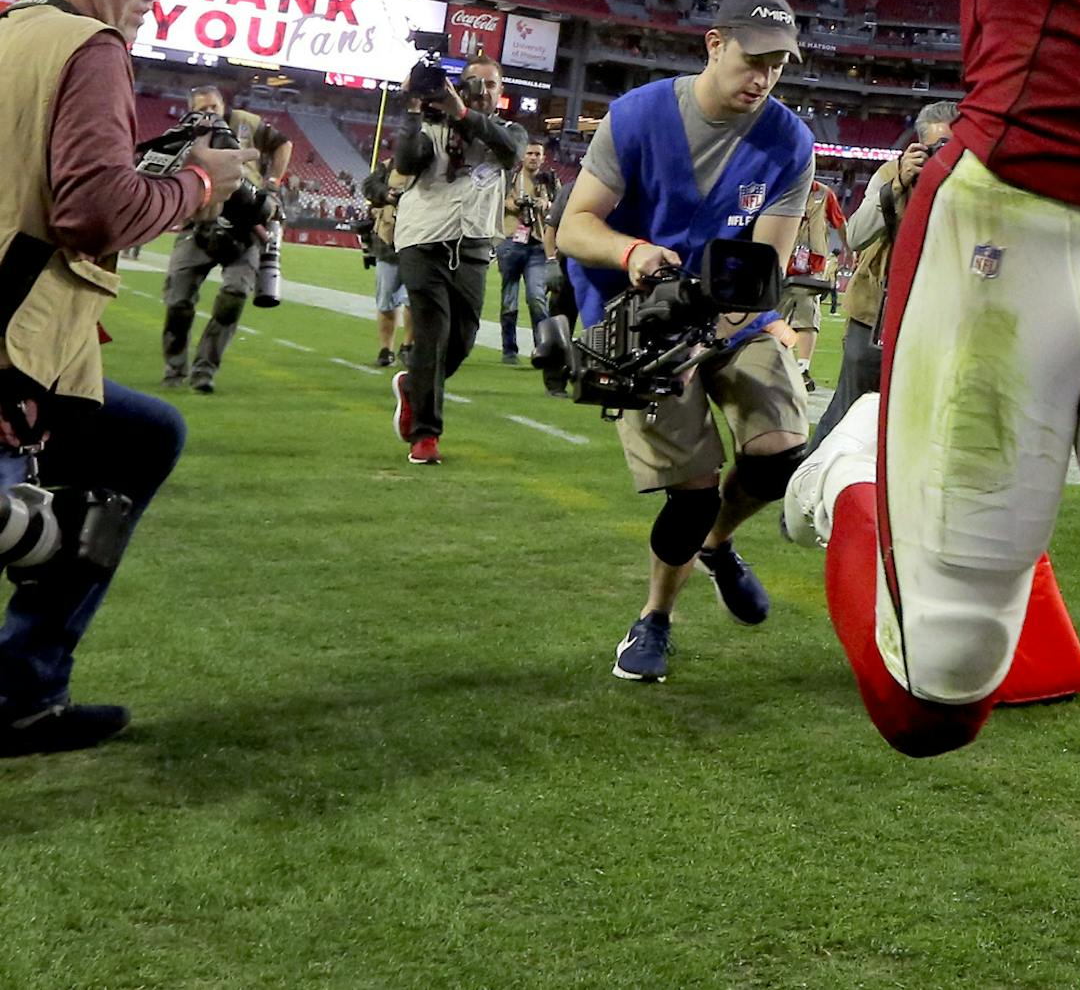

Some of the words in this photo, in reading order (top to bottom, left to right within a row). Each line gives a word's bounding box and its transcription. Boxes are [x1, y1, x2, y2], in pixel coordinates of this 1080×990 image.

[152, 0, 287, 57] YOU
[286, 13, 376, 61] Fans
[741, 194, 763, 208] NFL
[727, 215, 745, 226] NFL
